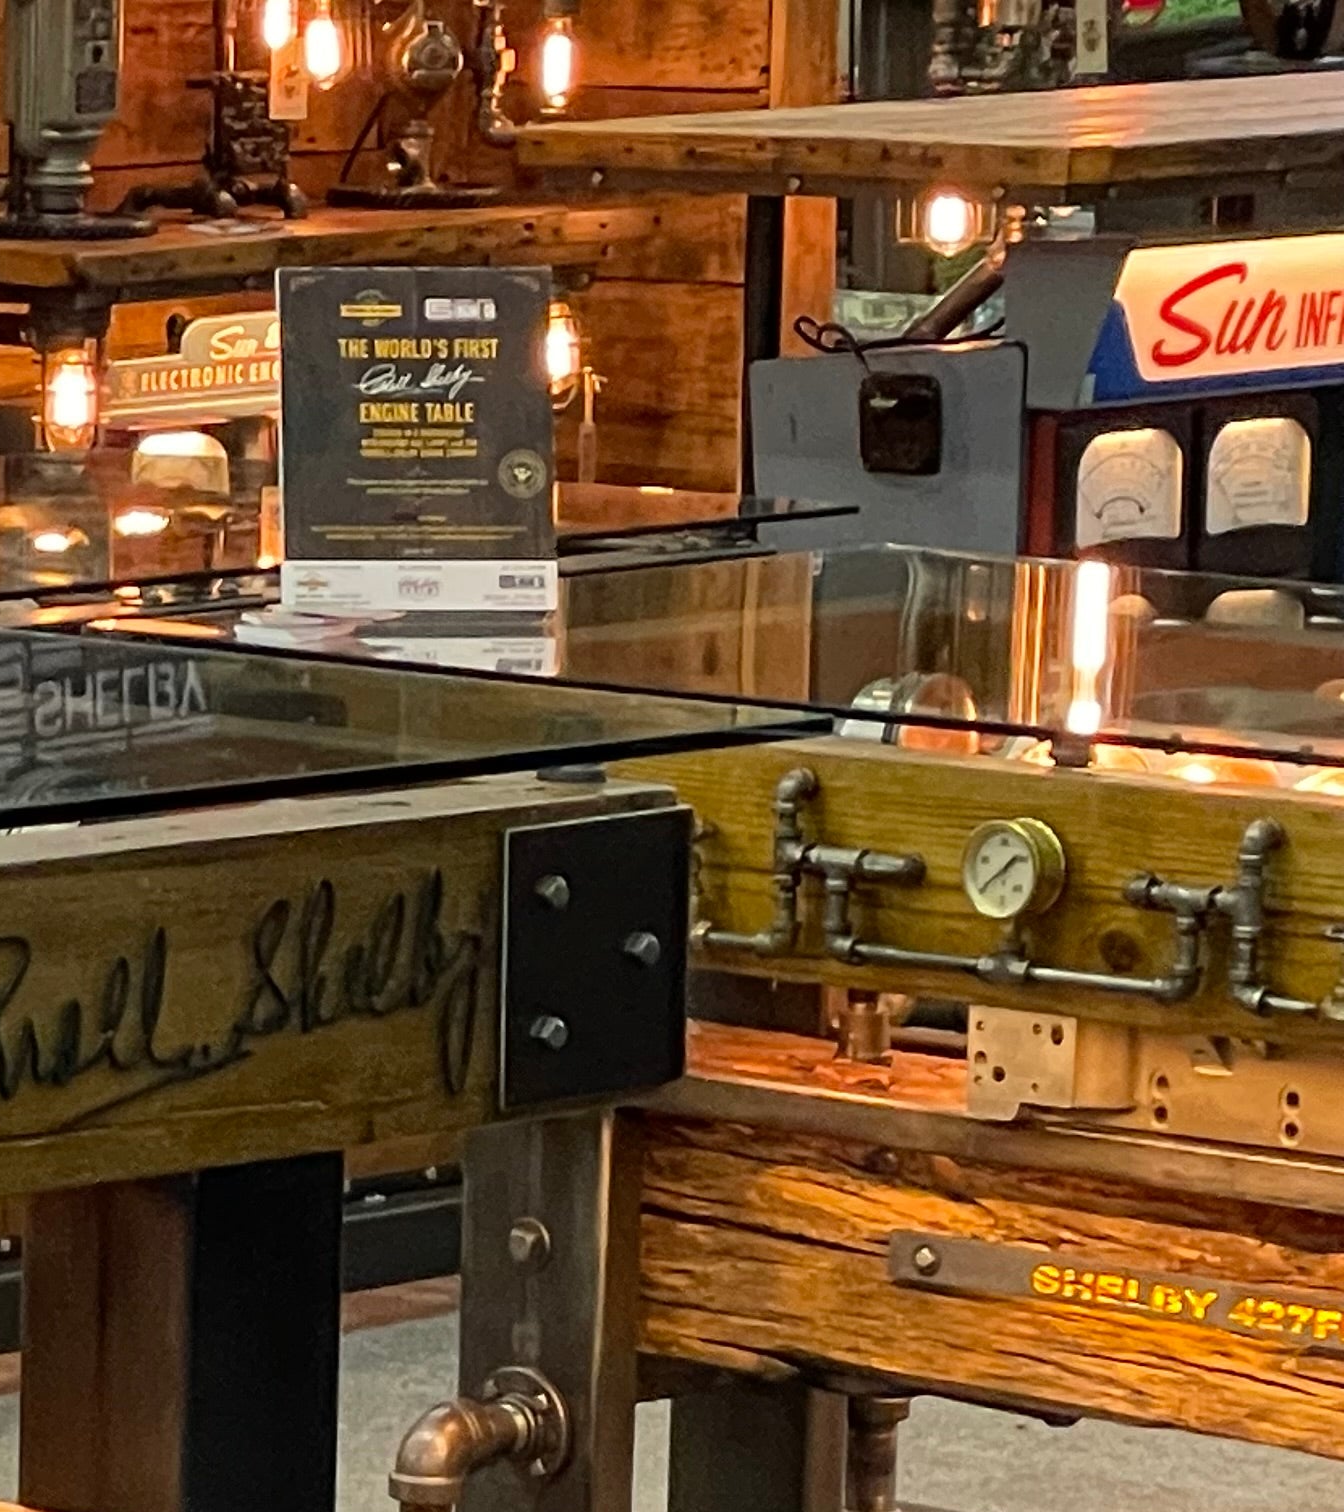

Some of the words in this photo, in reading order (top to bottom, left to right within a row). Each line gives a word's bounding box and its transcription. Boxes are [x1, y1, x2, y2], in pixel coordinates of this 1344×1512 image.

[1152, 261, 1289, 367] Sun
[1294, 290, 1344, 349] INF
[209, 325, 259, 360] Sun
[338, 338, 369, 358] THE
[373, 337, 450, 359] WORLD'S
[453, 337, 499, 359] FIRST
[140, 363, 244, 392] ELECTRONIC
[360, 402, 420, 423] ENGINE
[425, 402, 475, 423] TABLE
[1030, 1264, 1219, 1321] SHELBY
[1226, 1297, 1344, 1341] 427F
